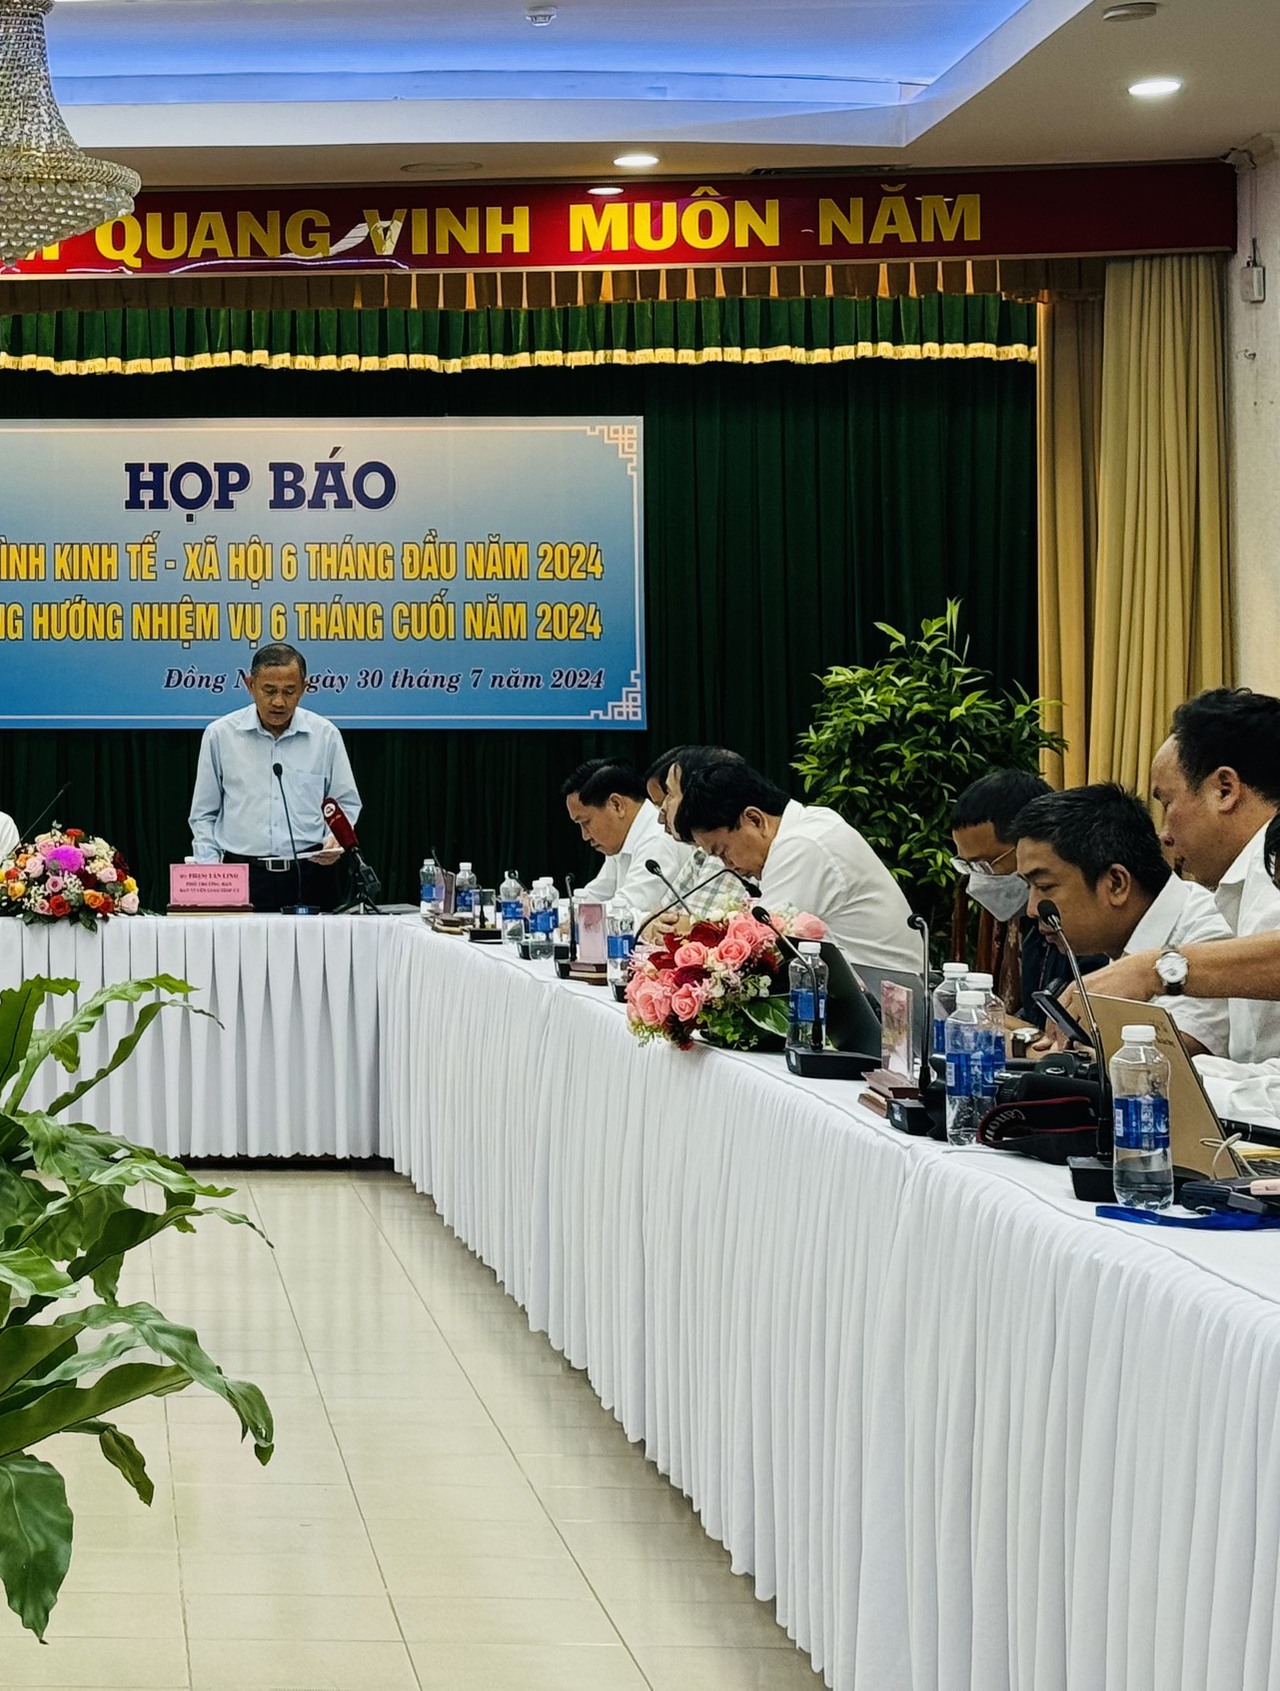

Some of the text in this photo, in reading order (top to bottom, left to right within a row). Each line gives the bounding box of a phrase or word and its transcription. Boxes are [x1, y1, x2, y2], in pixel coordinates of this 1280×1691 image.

[95, 209, 331, 267] QUANG
[363, 206, 530, 255] VINH
[569, 186, 780, 252] MUÔN
[819, 183, 981, 246] NĂM
[124, 446, 397, 523] HỌP BÁO
[54, 543, 118, 581] KINH
[126, 531, 161, 581] TẾ
[165, 559, 176, 570] -
[183, 535, 221, 581] XÃ
[228, 535, 273, 589] HỘI
[280, 543, 298, 581] 6
[305, 535, 394, 581] THÁNG
[402, 529, 457, 581] ĐẦU
[465, 534, 529, 581] NĂM
[536, 542, 604, 581] 2024
[32, 595, 123, 641] HƯỚNG
[131, 595, 220, 649] NHIỆM
[227, 603, 263, 649] VỤ
[270, 603, 287, 641] 6
[294, 594, 383, 641] THÁNG
[391, 589, 456, 641] CUỐI
[464, 594, 528, 641] NĂM
[535, 602, 603, 641] 2024
[164, 665, 227, 693] Đồng
[306, 669, 349, 693] gày
[357, 669, 384, 689] 30
[390, 668, 462, 693] tháng
[470, 669, 483, 689] 7
[490, 670, 543, 689] năm
[551, 668, 605, 689] 2024
[985, 1109, 1026, 1141] Canon
